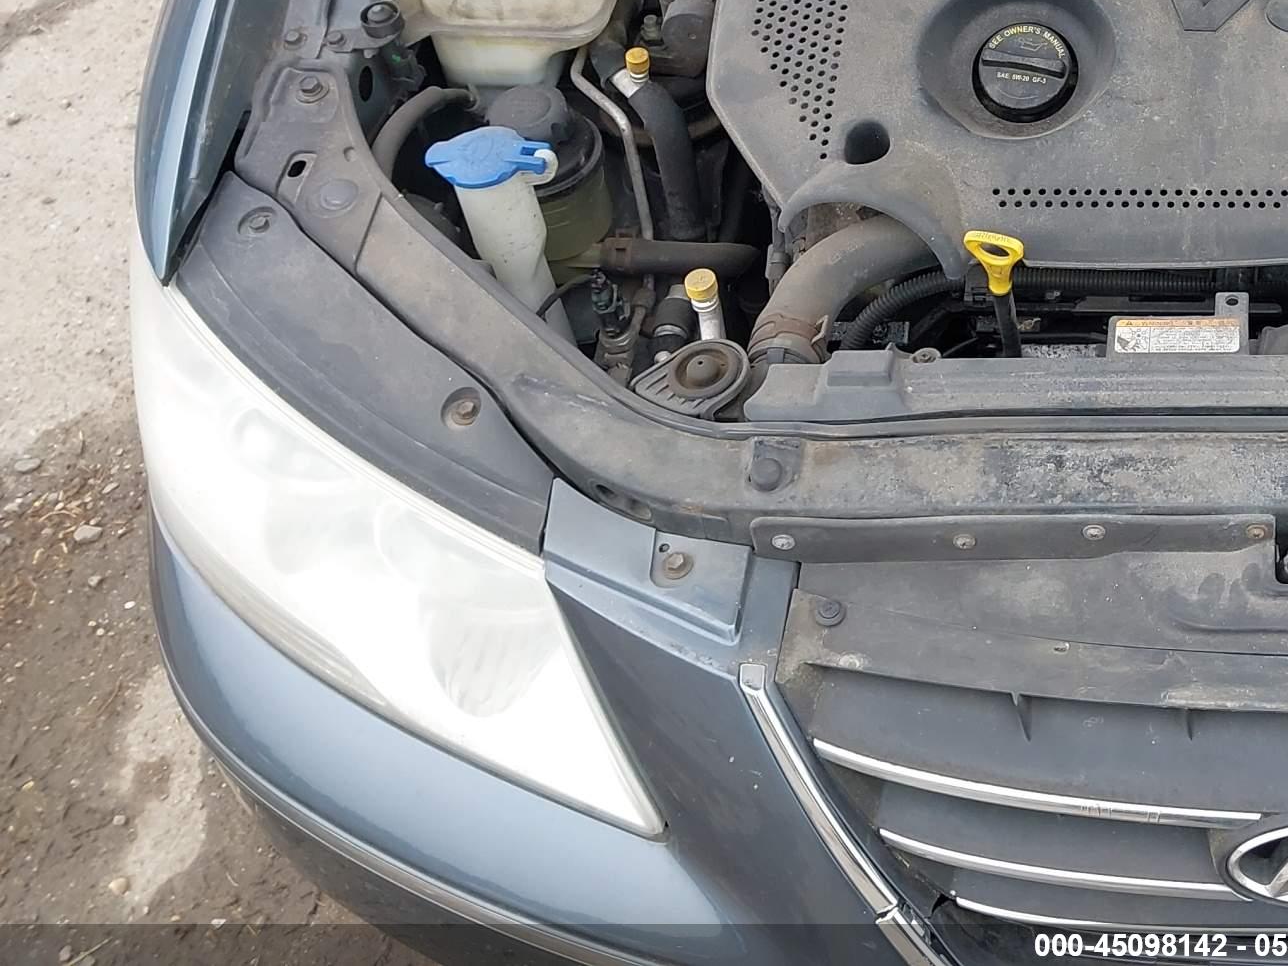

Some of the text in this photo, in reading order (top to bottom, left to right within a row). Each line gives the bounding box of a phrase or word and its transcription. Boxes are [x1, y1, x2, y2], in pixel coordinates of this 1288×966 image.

[988, 25, 1066, 58] SEE OWNER'S MANUAL
